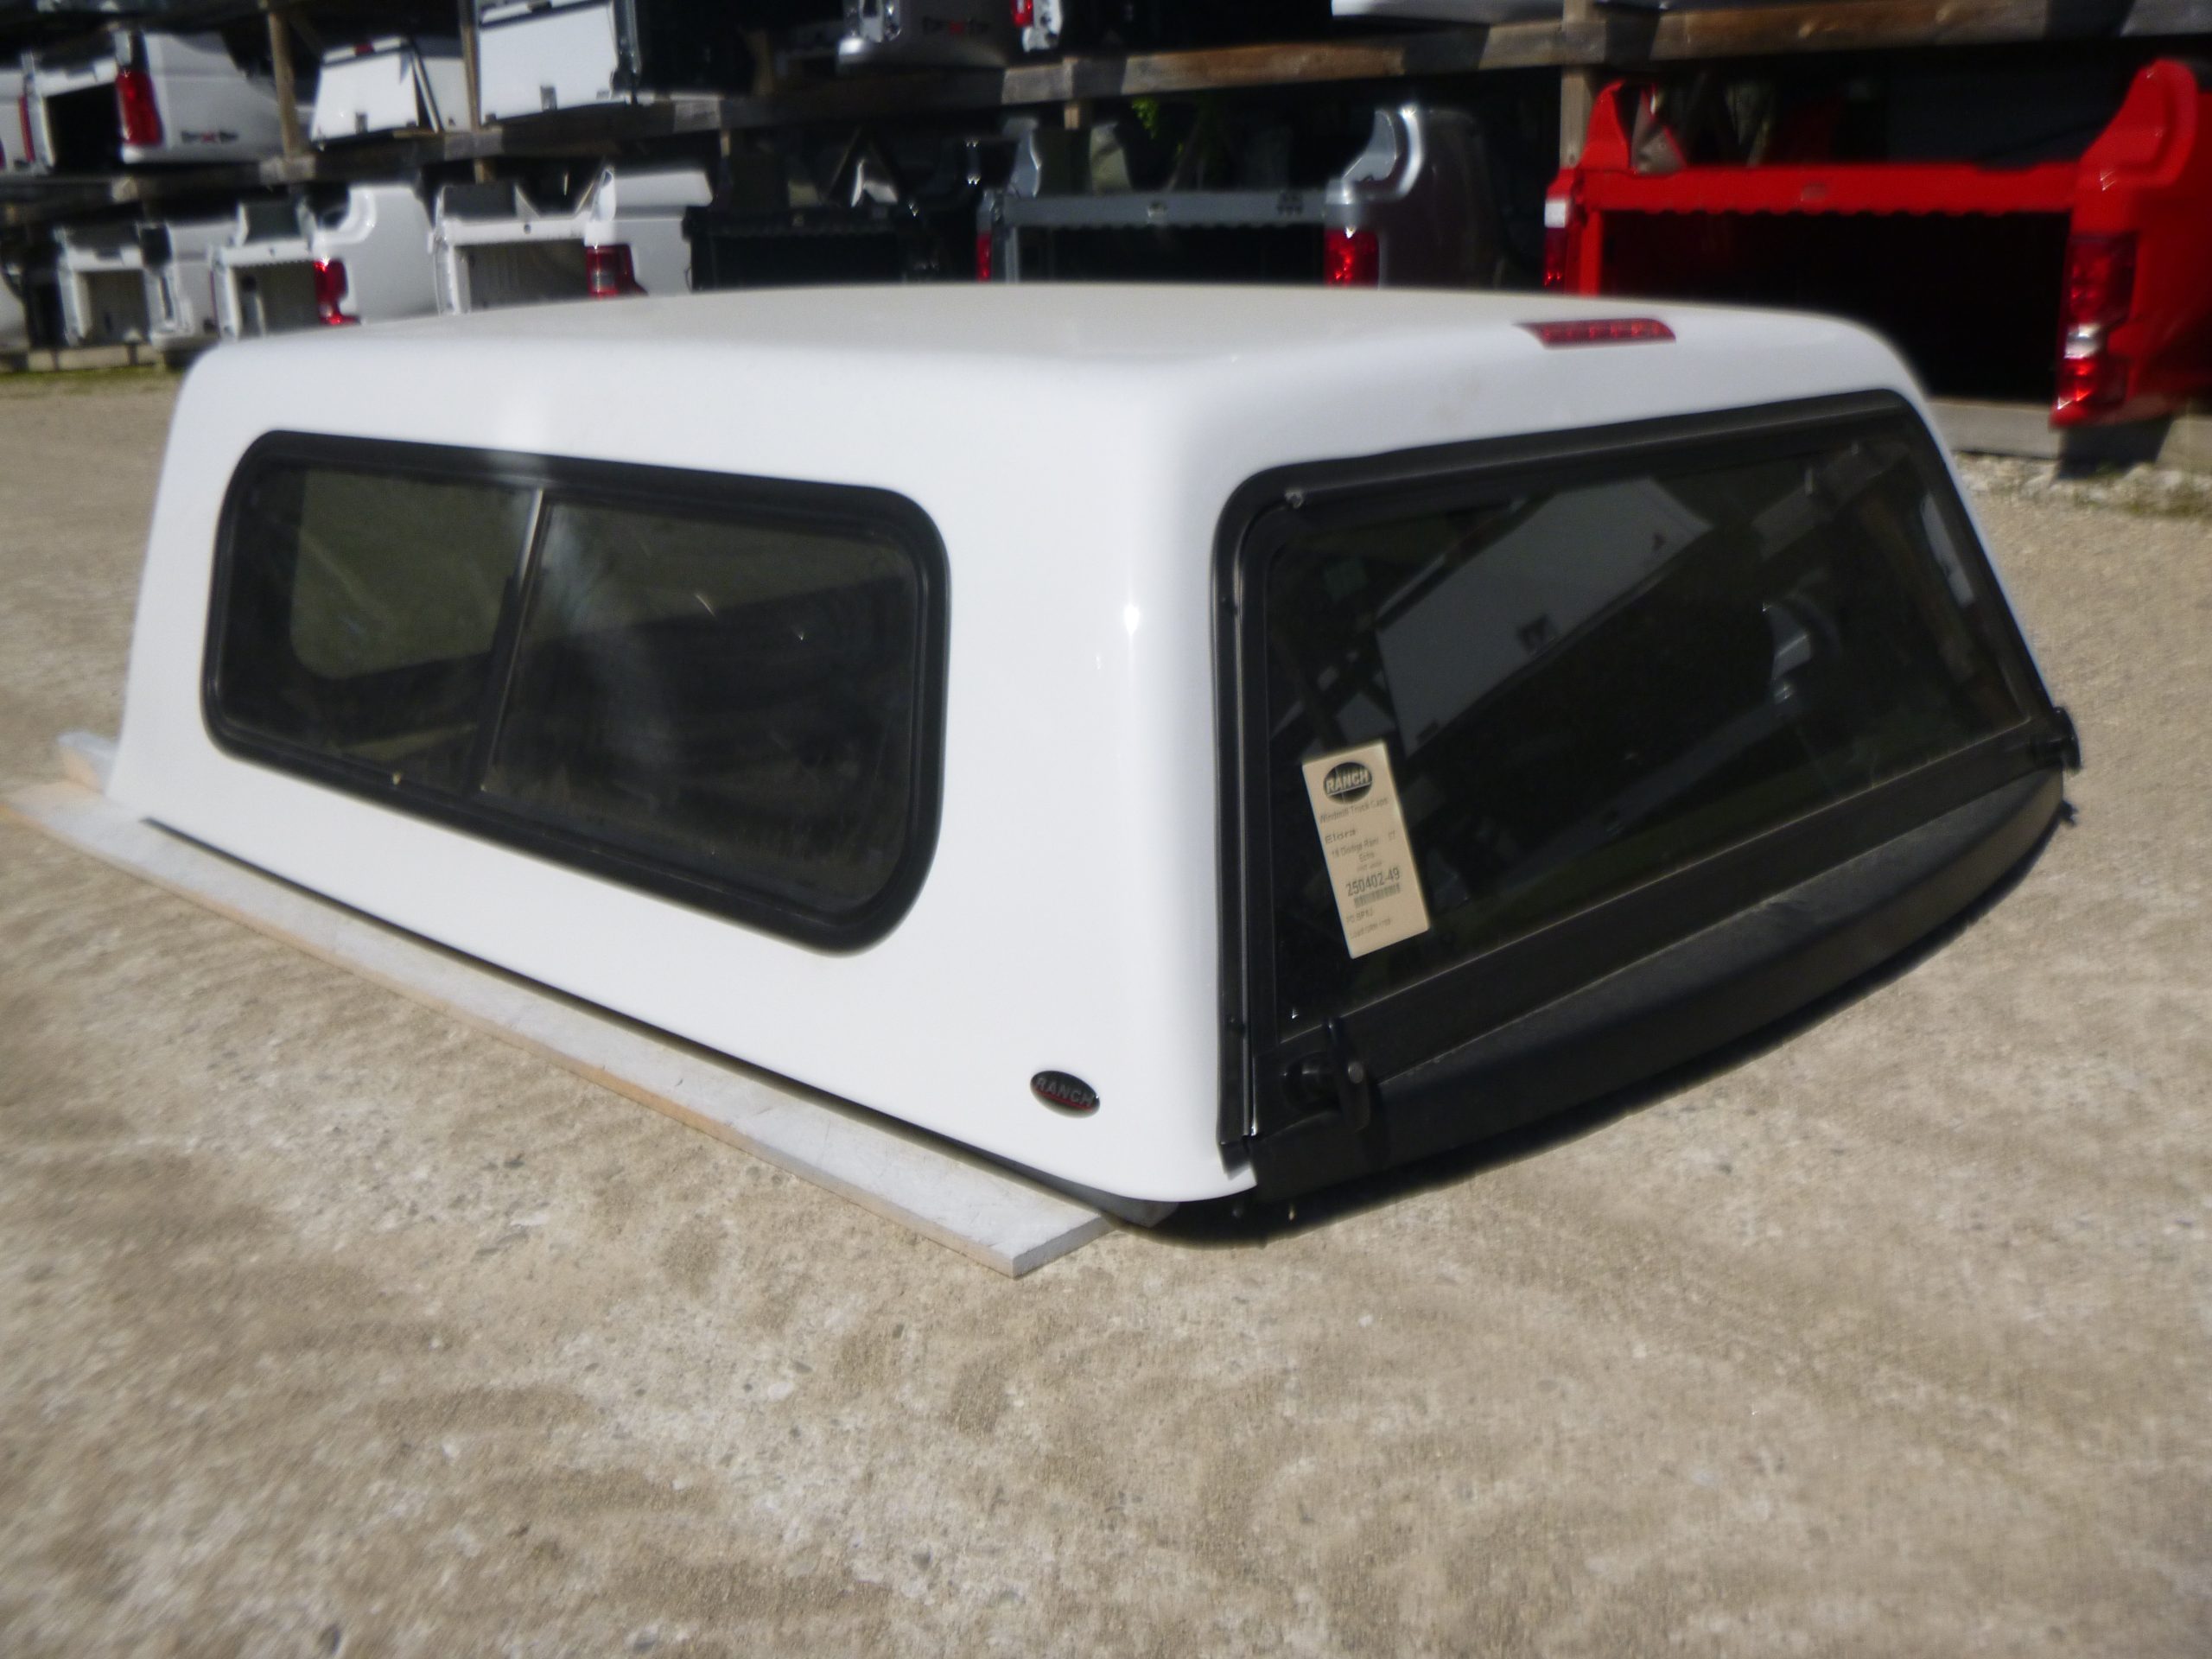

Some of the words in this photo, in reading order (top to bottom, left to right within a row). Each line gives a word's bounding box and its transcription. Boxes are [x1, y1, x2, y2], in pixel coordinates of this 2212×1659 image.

[1325, 768, 1370, 794] RANCH
[1345, 867, 1400, 897] 250402-49
[1036, 1077, 1096, 1107] RANCH
